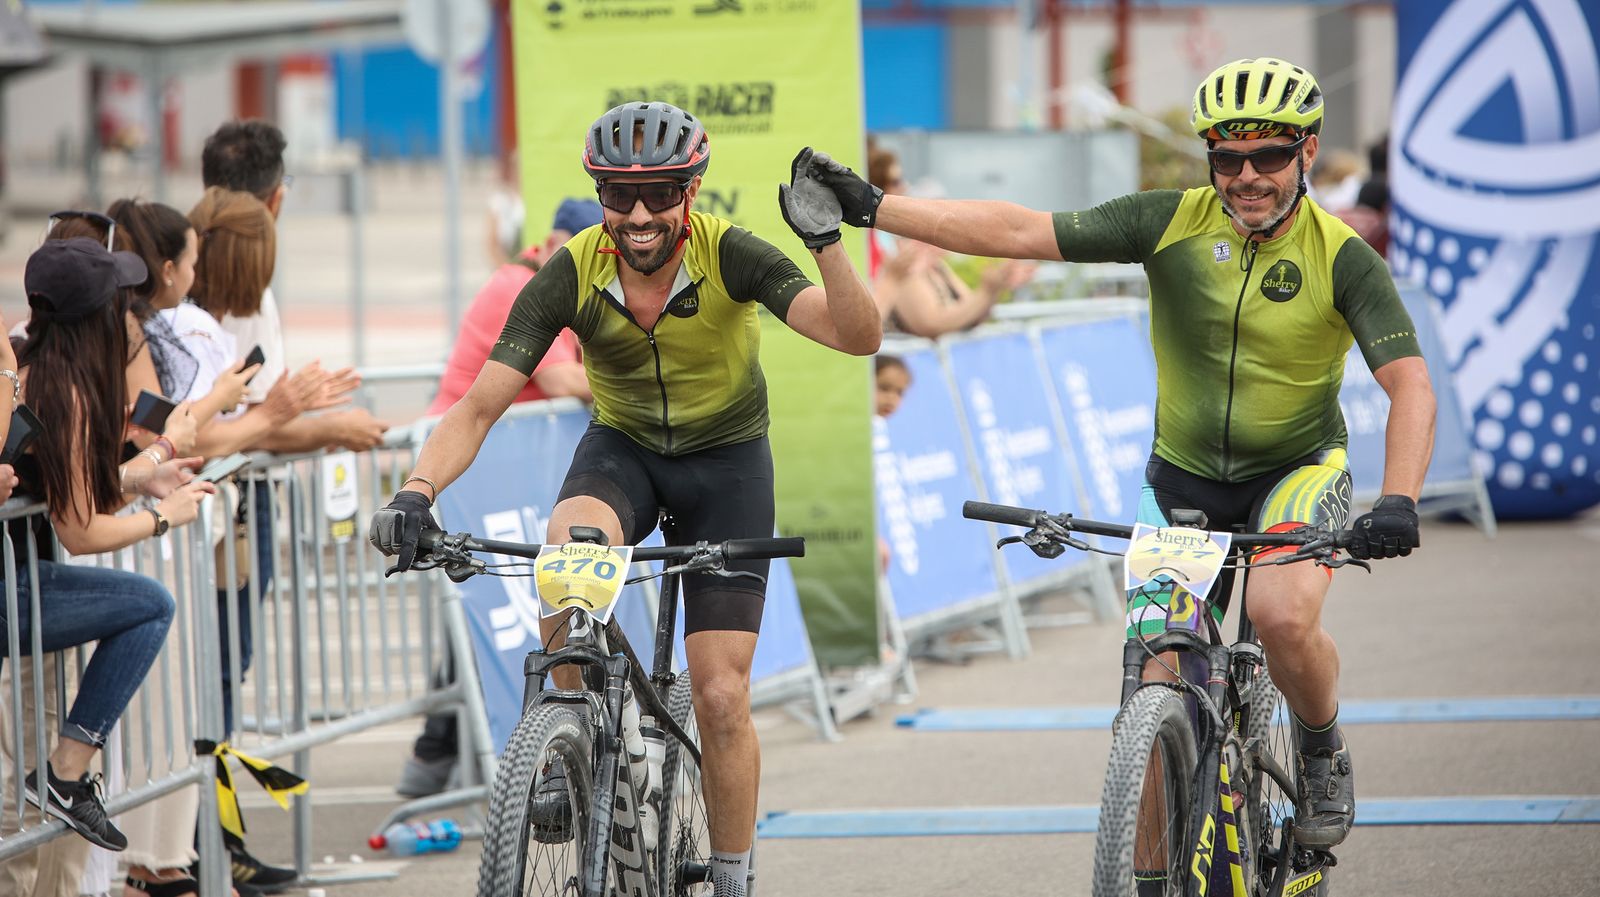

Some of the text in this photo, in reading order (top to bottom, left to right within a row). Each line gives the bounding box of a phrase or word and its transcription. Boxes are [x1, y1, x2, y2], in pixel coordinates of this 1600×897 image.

[697, 81, 774, 116] RACER
[1294, 79, 1311, 106] SCOTT
[1263, 278, 1298, 293] Sherry
[509, 342, 533, 357] BIKE
[1370, 332, 1409, 348] SHERRY
[542, 557, 617, 580] 470
[1286, 872, 1320, 897] SCOTT
